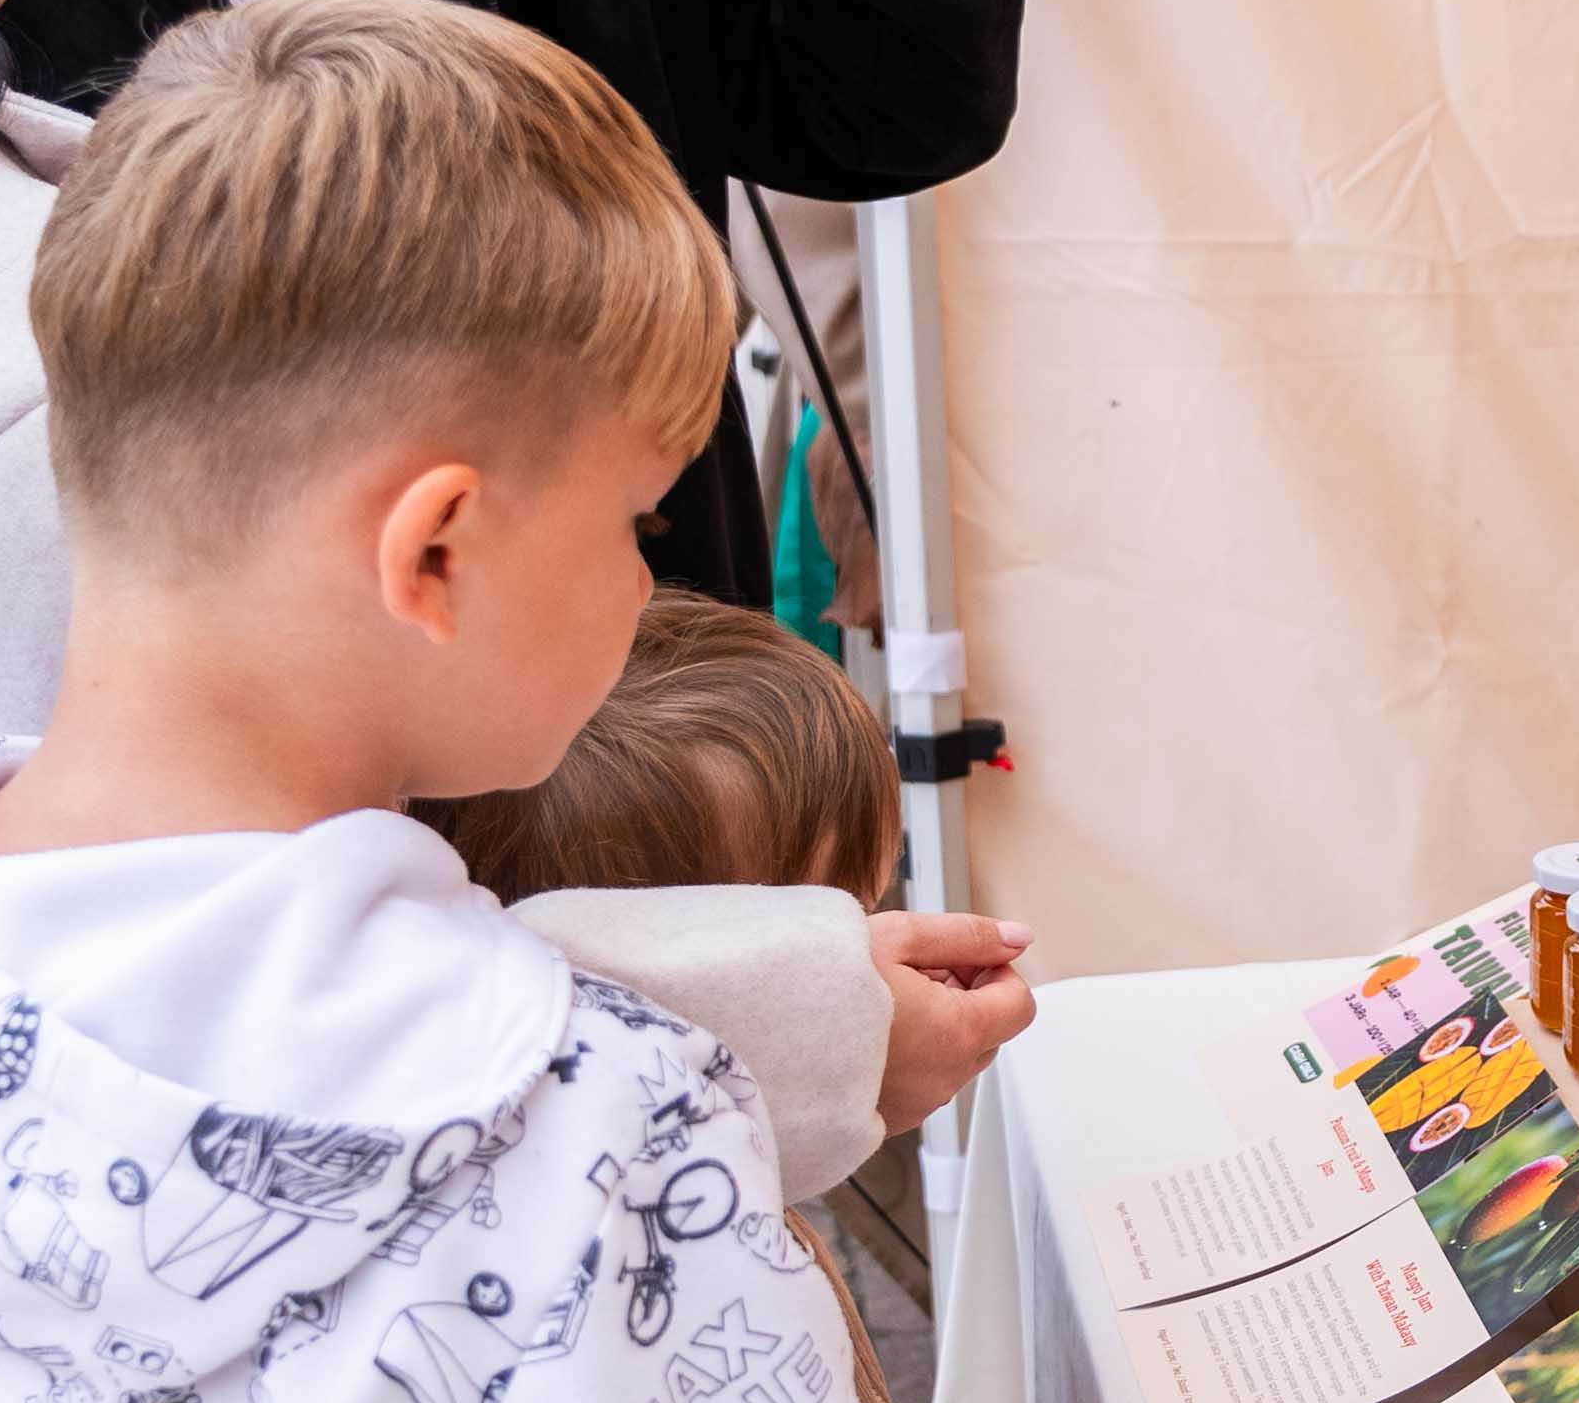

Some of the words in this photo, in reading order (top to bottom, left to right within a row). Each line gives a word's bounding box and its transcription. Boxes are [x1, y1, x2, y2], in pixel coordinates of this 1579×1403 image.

[1316, 1159, 1335, 1177] Jam
[1330, 1116, 1350, 1145] Passion
[1343, 1141, 1362, 1163] Fruit
[1356, 1165, 1376, 1193] Mango
[1365, 1259, 1386, 1283] With
[1400, 1262, 1423, 1295] Mango
[1375, 1279, 1398, 1313] Taiwan
[1411, 1291, 1433, 1313] Jam
[1390, 1310, 1417, 1348] Makauy
